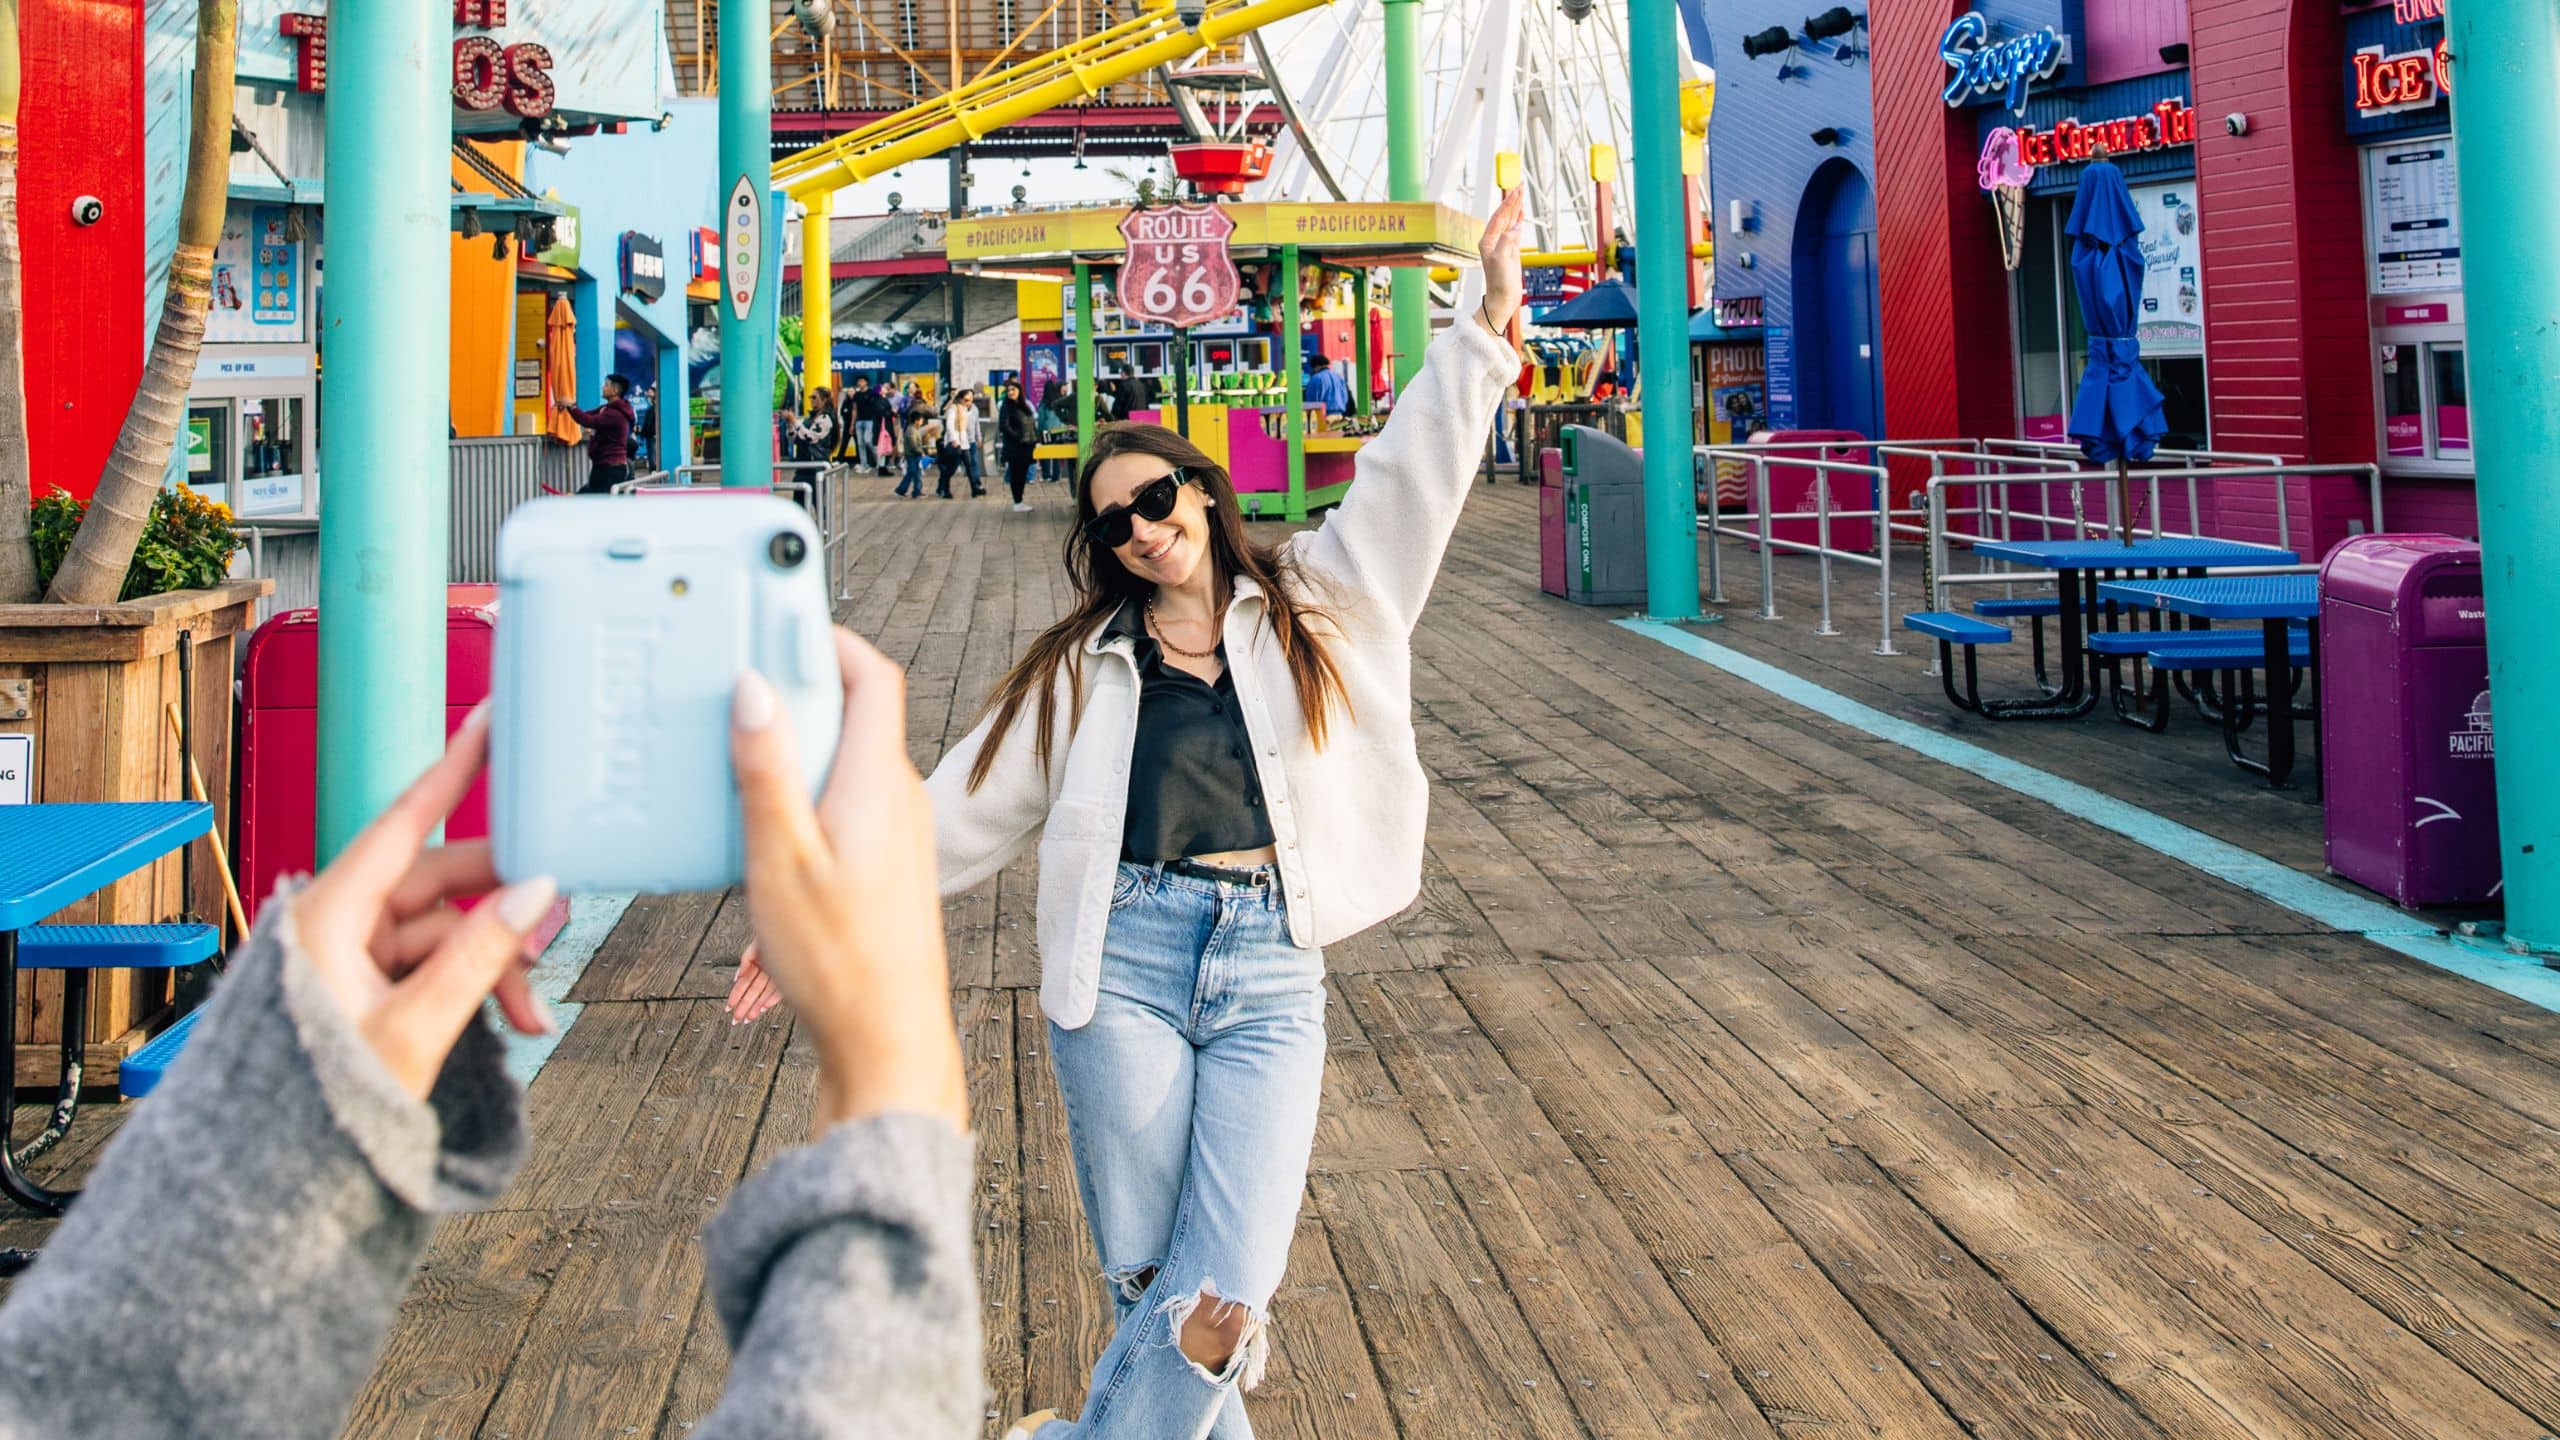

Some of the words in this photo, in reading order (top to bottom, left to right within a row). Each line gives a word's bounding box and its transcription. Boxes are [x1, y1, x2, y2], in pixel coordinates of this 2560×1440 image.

[2352, 51, 2434, 111] ICE
[2016, 125, 2055, 167] ICE
[2054, 118, 2129, 162] CREAM
[2132, 115, 2153, 148] &
[1138, 215, 1217, 240] ROUTE
[1296, 215, 1406, 232] #PACIFICPARK
[966, 226, 1046, 247] #PACIFICPARK
[1143, 266, 1215, 314] 66
[844, 359, 887, 370] Pretzels
[1581, 503, 1590, 547] COMPOST
[1582, 549, 1591, 573] ONLY
